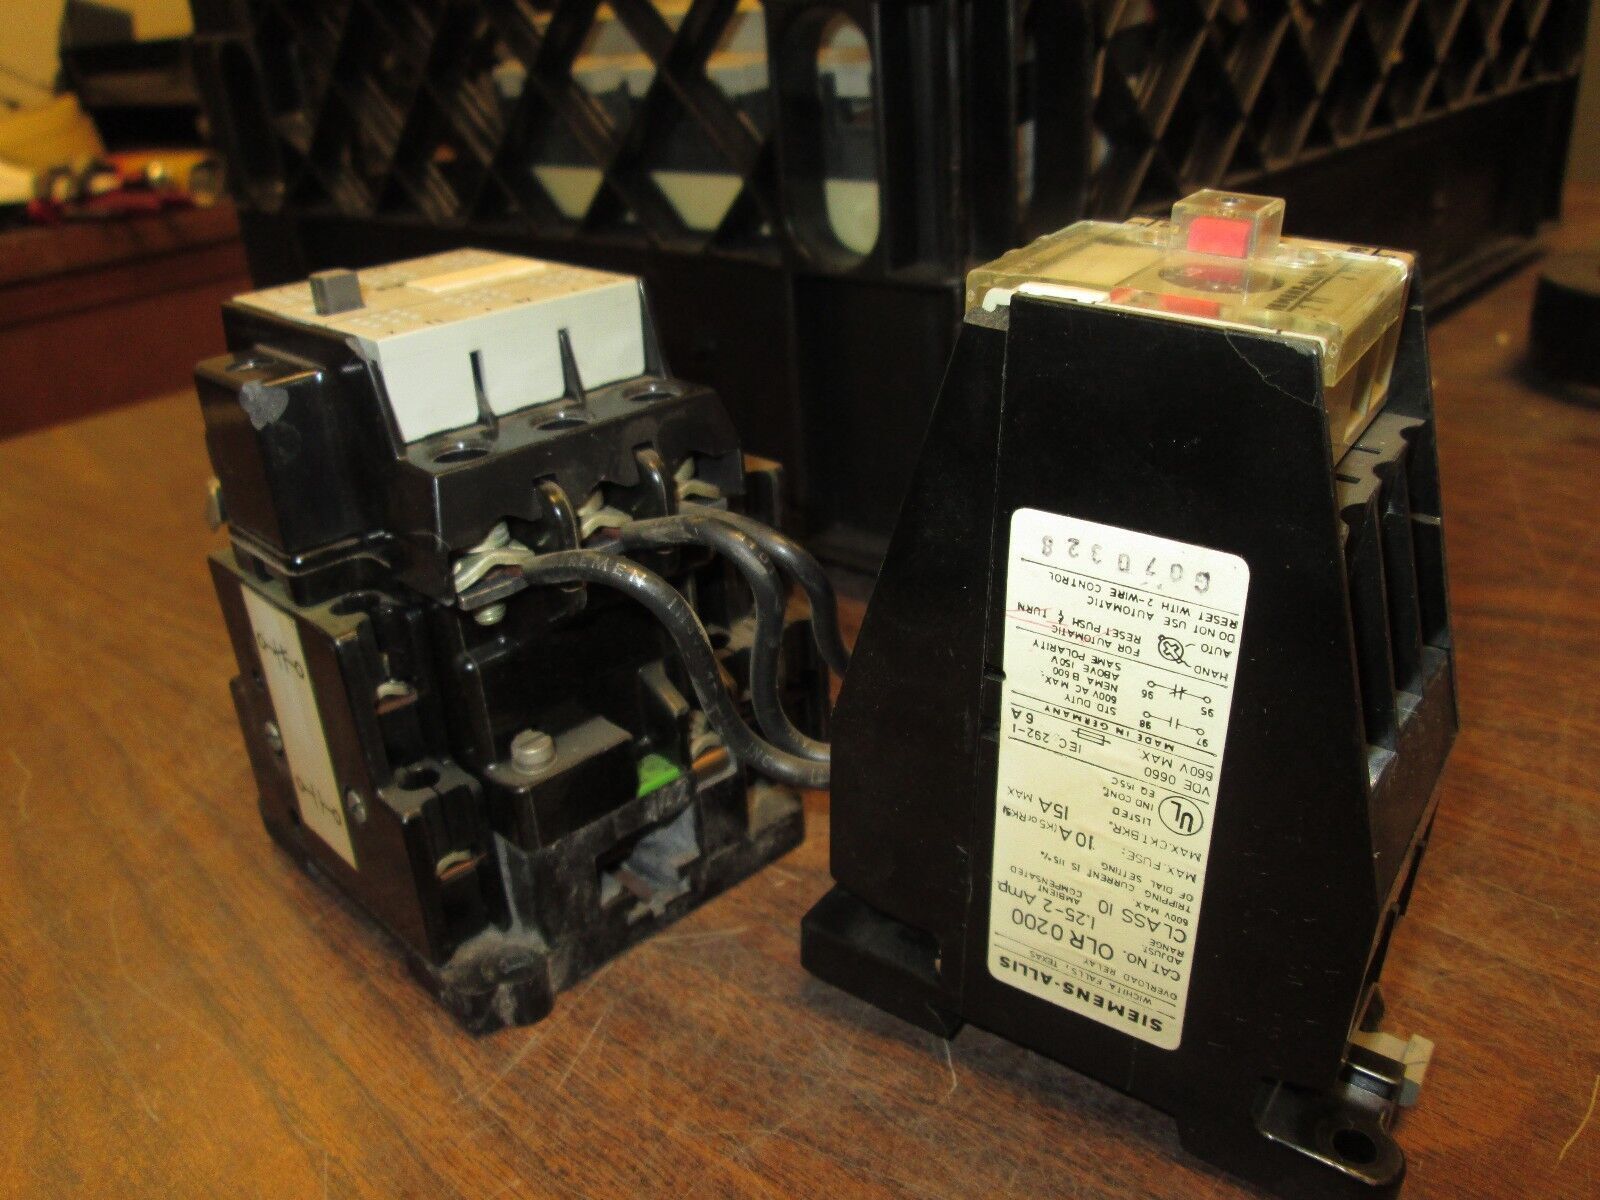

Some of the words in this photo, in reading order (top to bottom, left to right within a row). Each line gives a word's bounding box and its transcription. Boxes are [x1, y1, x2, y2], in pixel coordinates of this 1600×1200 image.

[1049, 571, 1102, 593] CONTROL
[1017, 602, 1047, 618] TURN
[1086, 595, 1154, 621] AUTOMATIC
[1161, 601, 1191, 616] WITH
[1072, 617, 1101, 633] PUSH
[1163, 616, 1187, 630] USE
[1198, 611, 1238, 629] RESET
[1051, 624, 1112, 649] AUTOMATIC
[1105, 627, 1141, 644] RESET
[1193, 624, 1216, 638] NOT
[1218, 630, 1235, 643] DO
[1033, 638, 1085, 661] POLARITY
[1117, 643, 1140, 657] FOR
[1200, 642, 1232, 659] AUTO
[1091, 655, 1121, 671] SAME
[1083, 664, 1119, 681] ABOVE
[1193, 664, 1228, 681] HAND
[1075, 684, 1088, 695] AC
[1087, 677, 1118, 693] NEMA
[1064, 693, 1091, 708] DUTY
[1093, 690, 1117, 704] 600V
[1141, 688, 1154, 700] 96
[1045, 705, 1108, 731] GERMANY
[1200, 706, 1214, 718] 95
[1116, 727, 1129, 737] IN
[1139, 719, 1151, 730] 98
[1137, 733, 1174, 751] MADE
[1197, 736, 1208, 748] 97
[1144, 766, 1176, 786] 0660
[1140, 786, 1155, 798] EQ
[1184, 779, 1211, 797] VDE
[1112, 806, 1151, 827] LISTED
[1072, 862, 1080, 872] IS
[1101, 862, 1142, 883] SETTING
[1010, 865, 1082, 898] COMPENSATED
[1087, 868, 1134, 892] CURRENT
[1150, 880, 1173, 894] DIAL
[1038, 884, 1080, 906] AMBIENT
[1144, 889, 1191, 913] TRIPPING
[1179, 890, 1194, 902] OF
[1098, 898, 1112, 916] 10
[1012, 907, 1063, 942] 0200
[1122, 908, 1187, 945] CLASS
[1069, 930, 1114, 962] OLR
[1149, 938, 1184, 958] RANGE
[1030, 950, 1057, 967] TEXAS
[1084, 958, 1116, 976] RELAY
[1123, 951, 1146, 968] NO.
[1000, 955, 1163, 1033] SIEMENS-ALLIS
[1109, 983, 1151, 1005] WICHITA
[1123, 973, 1177, 1001] OVERLOAD
